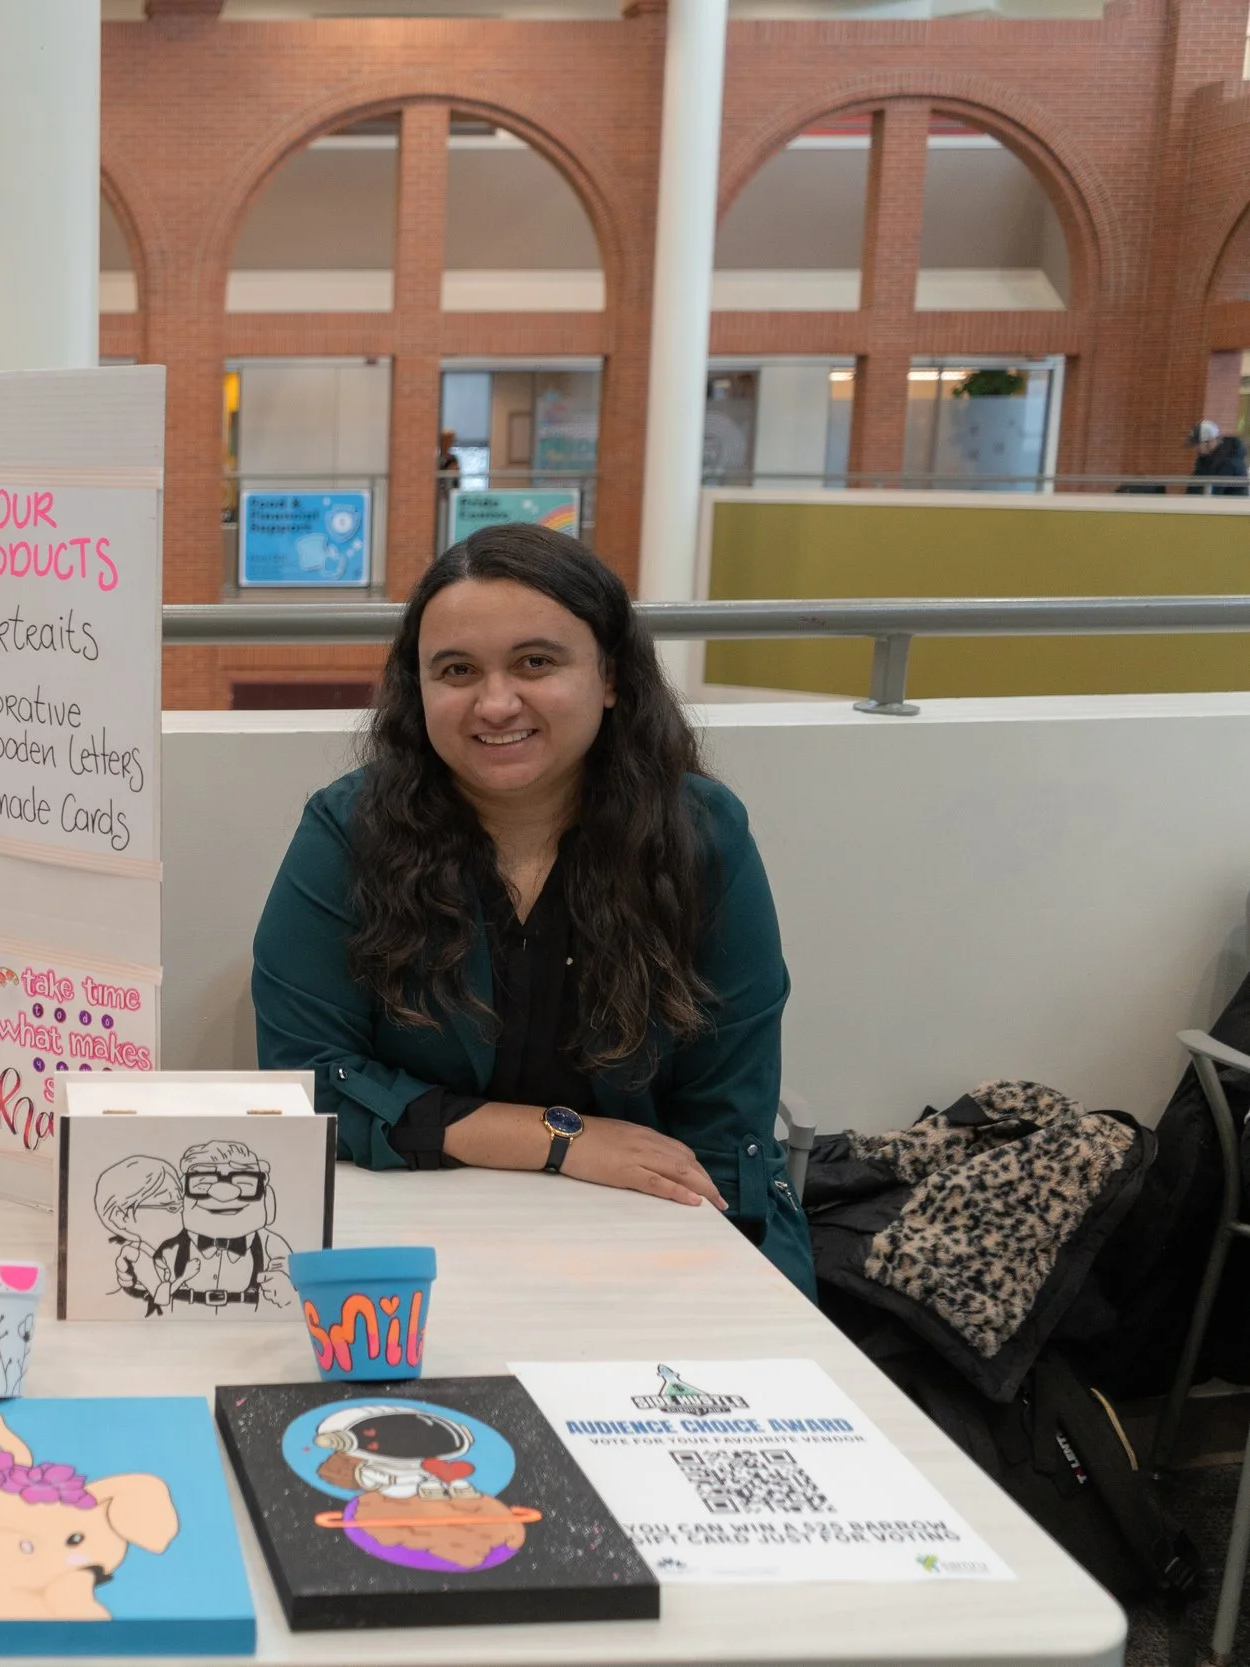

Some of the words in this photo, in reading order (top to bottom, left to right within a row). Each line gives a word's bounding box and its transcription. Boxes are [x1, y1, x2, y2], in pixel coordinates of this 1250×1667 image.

[61, 792, 129, 851] Cards
[21, 966, 74, 1003] take
[82, 975, 141, 1011] time
[69, 1031, 153, 1071] makes
[565, 1420, 678, 1435] AUDIENCE
[679, 1419, 765, 1433] CHOICE
[767, 1418, 855, 1432] AWARD
[589, 1437, 629, 1446] VOTE
[631, 1437, 665, 1445] FOR
[668, 1437, 711, 1445] YOUR
[713, 1436, 798, 1444] FAVOURITE
[801, 1435, 865, 1443] VENDOR
[623, 1522, 670, 1534] YOU
[677, 1522, 724, 1533] CAN
[729, 1521, 777, 1533] WIN
[687, 1532, 750, 1545] CARD
[867, 1529, 962, 1543] VOTING
